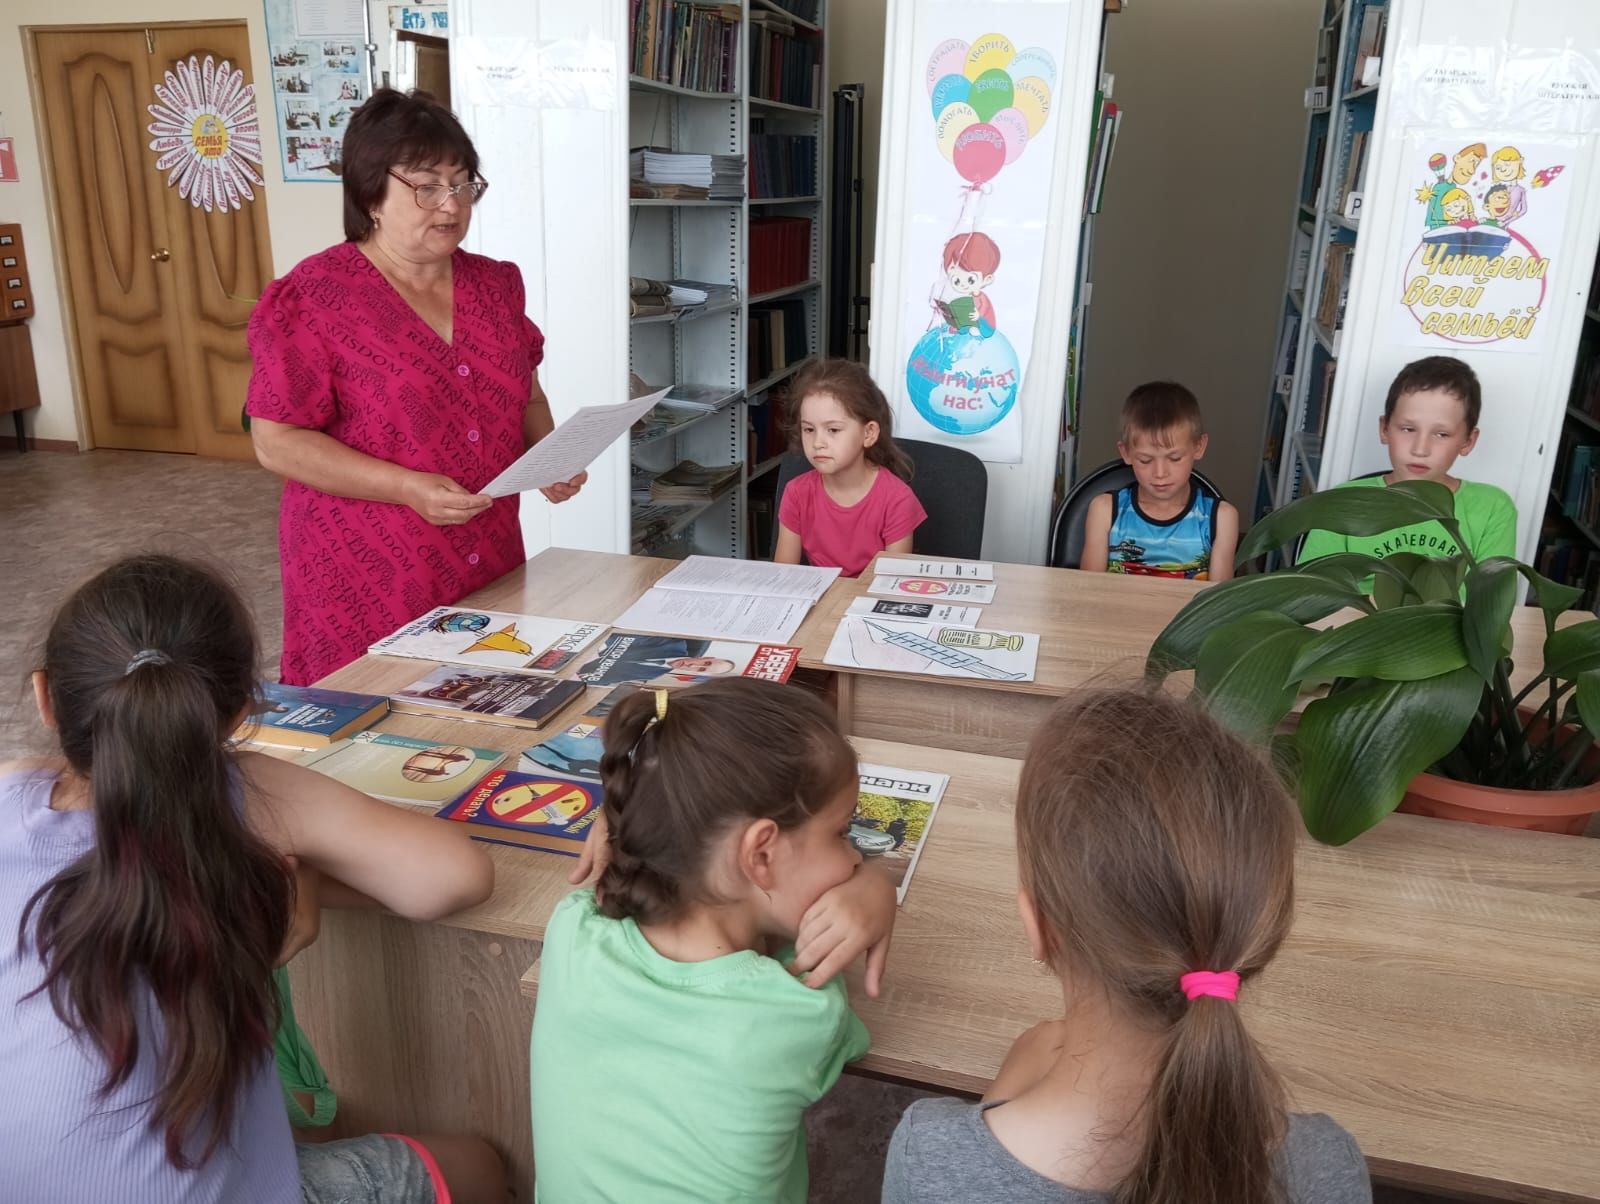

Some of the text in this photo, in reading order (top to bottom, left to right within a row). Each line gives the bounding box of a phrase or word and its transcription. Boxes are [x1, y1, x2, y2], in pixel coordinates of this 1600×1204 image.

[969, 41, 1009, 63] ТВОРИТЬ
[1016, 80, 1049, 113] МЕЧТАТЬ
[938, 107, 973, 139] ПОМОГАТЬ
[195, 135, 223, 147] СЕМЬЯ
[1417, 242, 1551, 280] Читаем
[1420, 306, 1541, 340] семьёй
[325, 321, 405, 377] WISDOM
[971, 368, 1017, 394] учат
[943, 394, 984, 411] нас:
[363, 400, 419, 458] WSDOM
[362, 503, 416, 573] WISDOM
[1373, 533, 1458, 560] SKATEBOAR
[587, 637, 636, 682] ВИКТОР ИВАНОВ
[757, 648, 794, 682] УБЕРЕ
